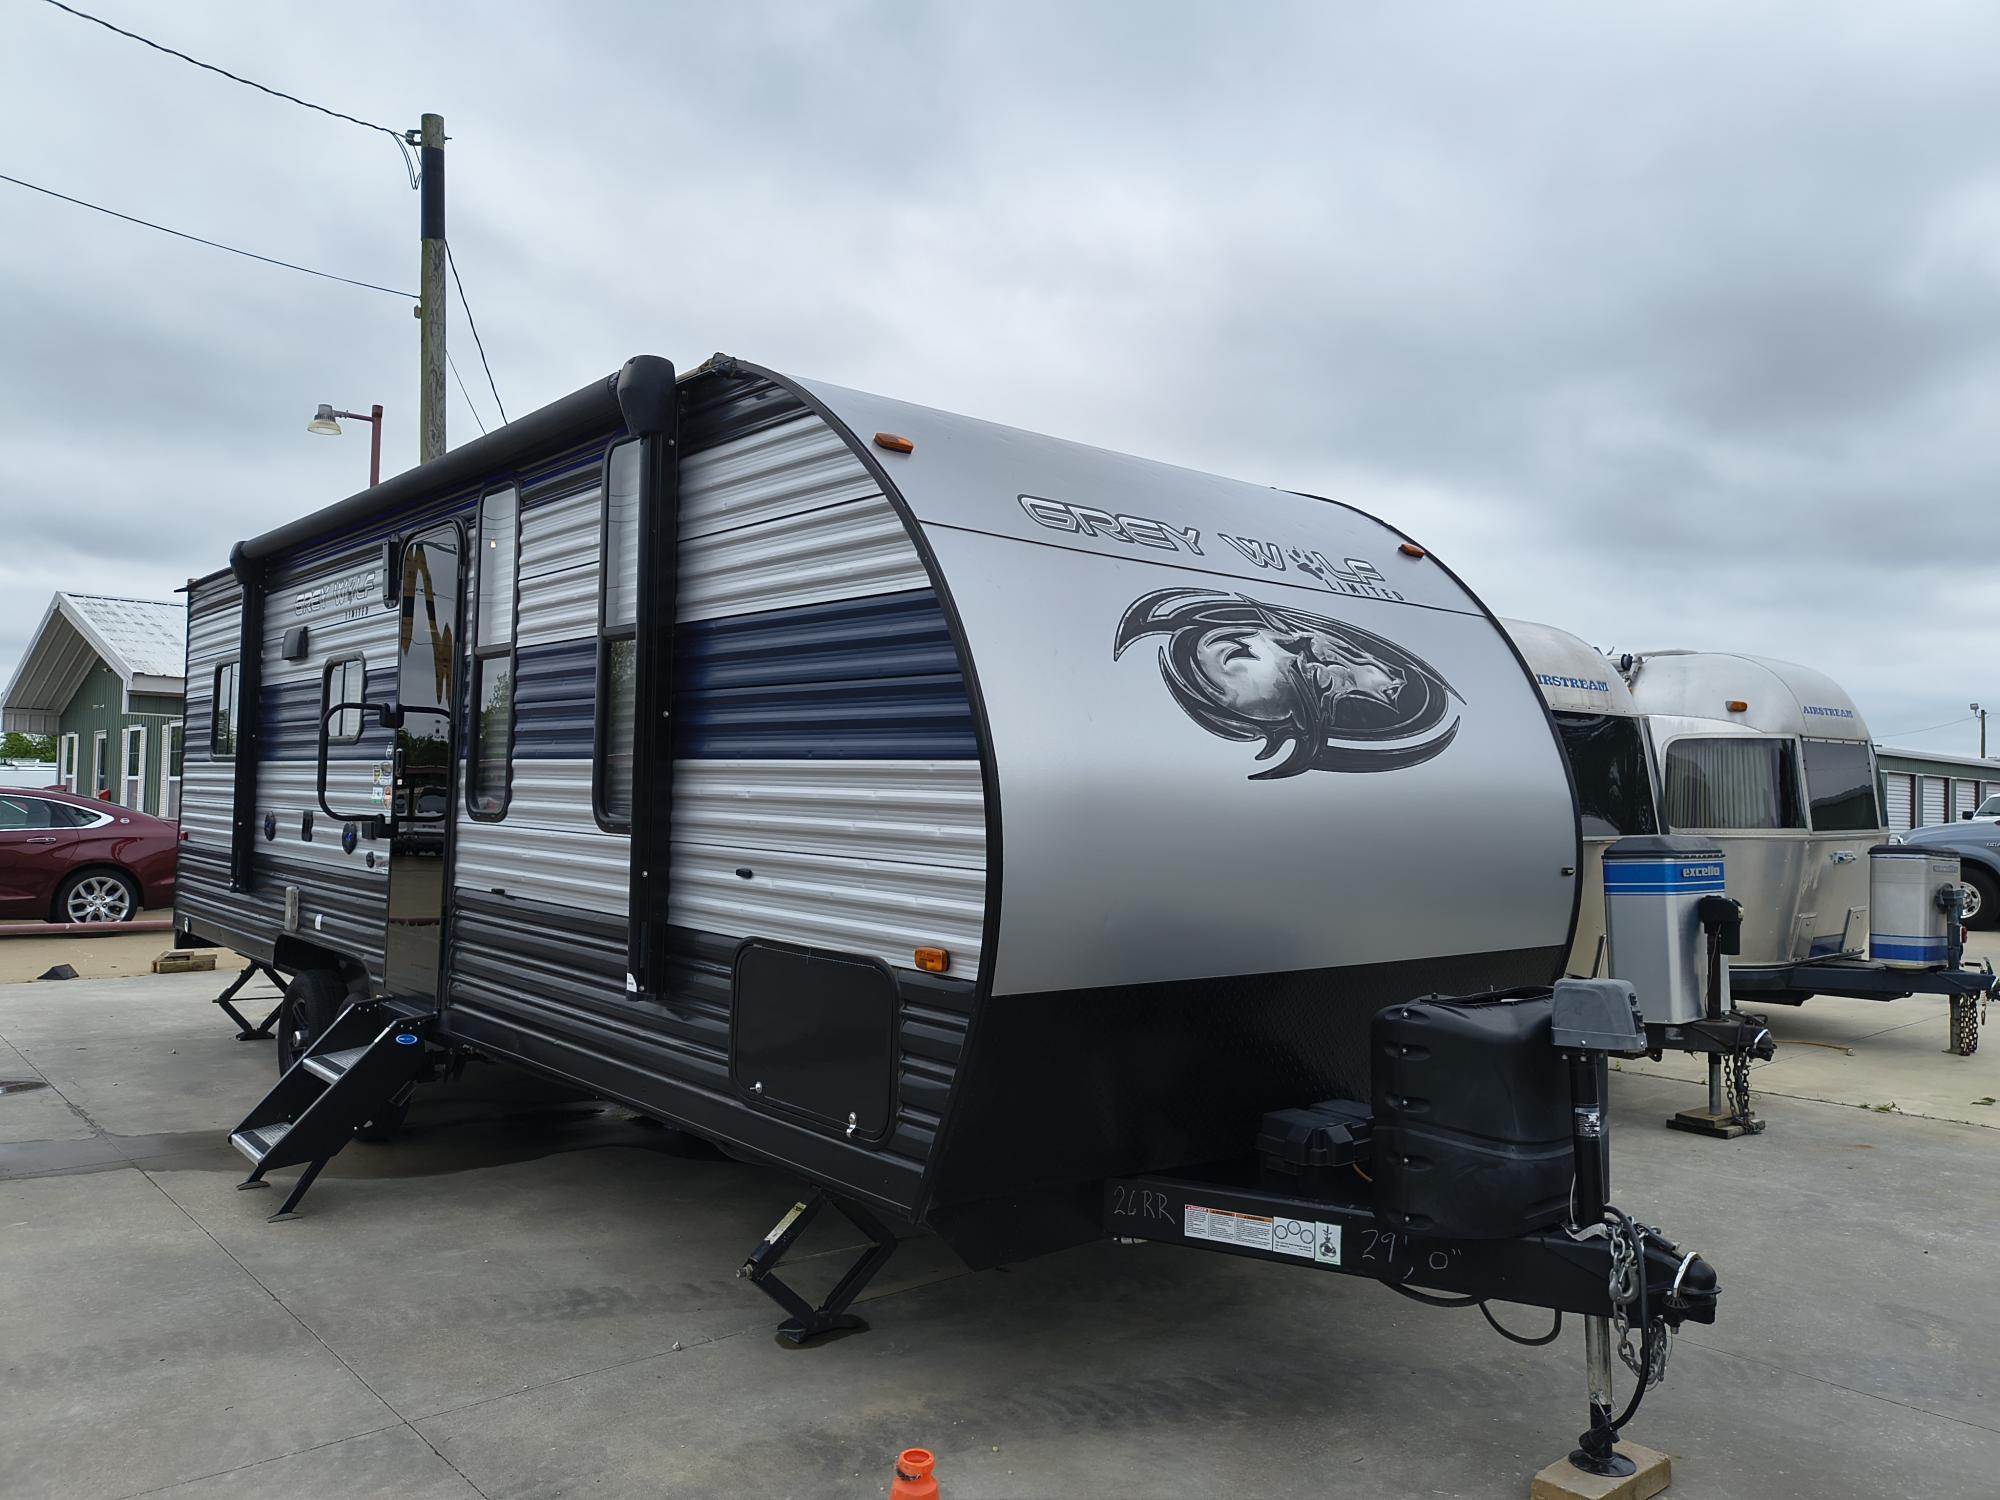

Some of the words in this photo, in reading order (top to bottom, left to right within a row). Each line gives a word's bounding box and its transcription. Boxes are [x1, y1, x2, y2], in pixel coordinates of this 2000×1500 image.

[1017, 493, 1205, 556] GREY
[1217, 532, 1386, 585] WLF
[1323, 578, 1406, 602] LIMITED
[1535, 673, 1609, 692] IRSTREAM
[1803, 705, 1854, 719] AIRSTREAM
